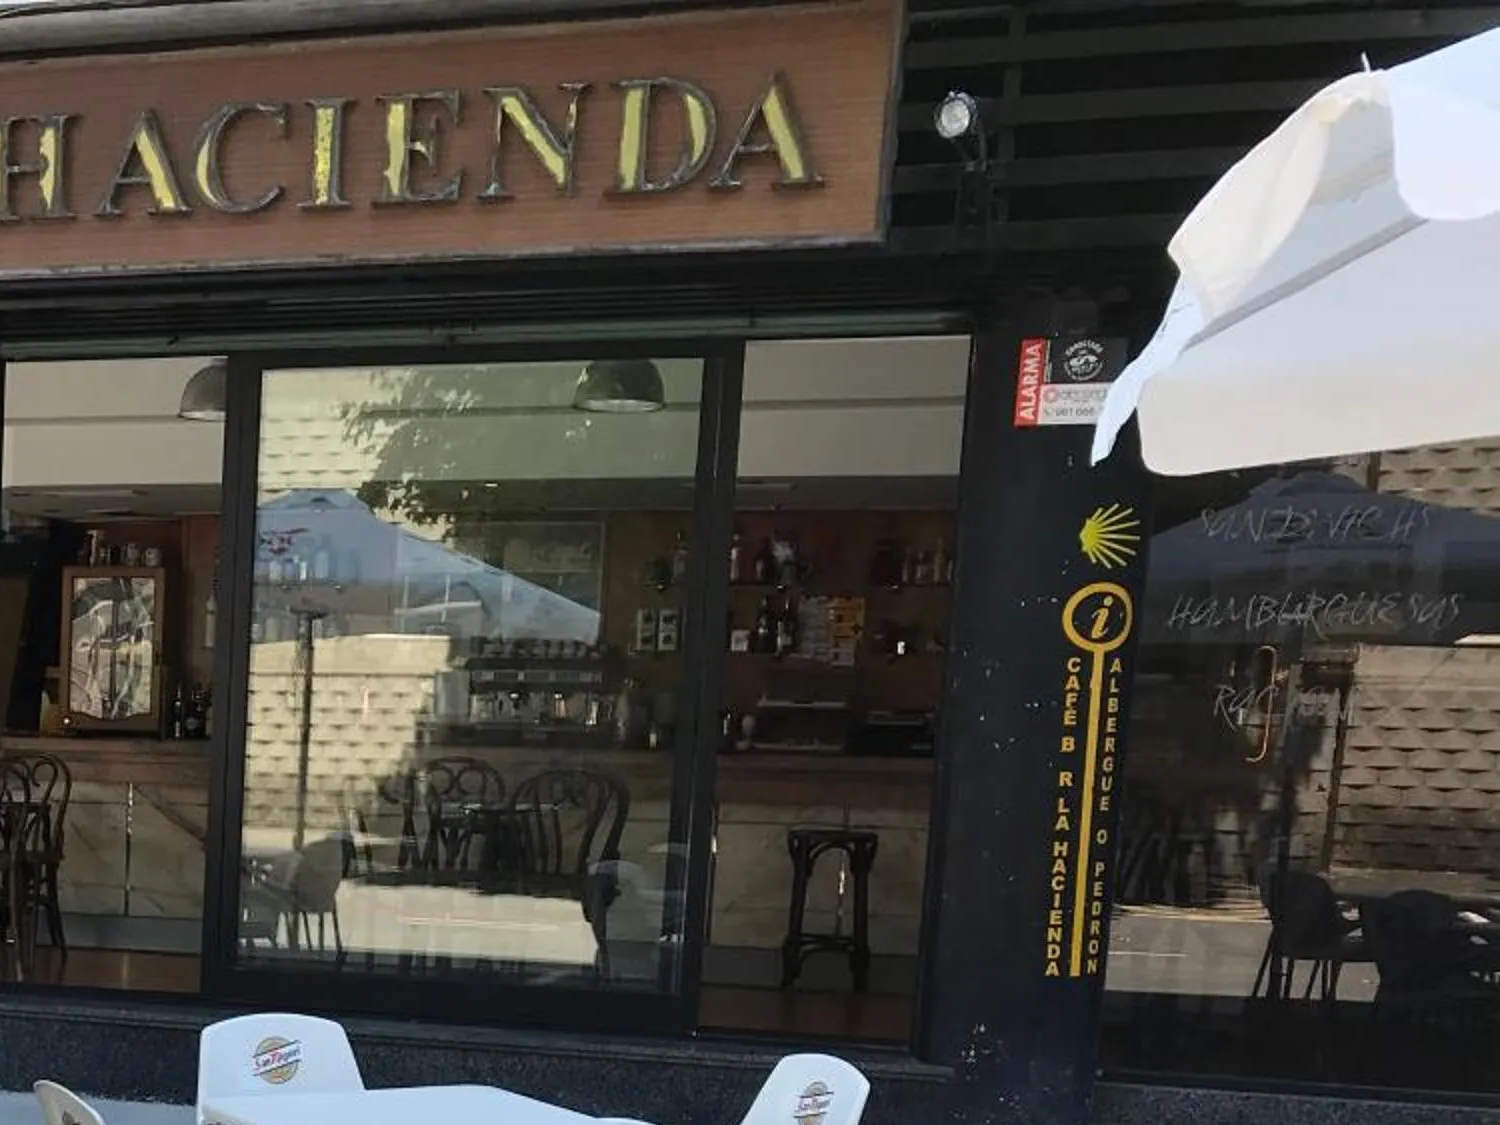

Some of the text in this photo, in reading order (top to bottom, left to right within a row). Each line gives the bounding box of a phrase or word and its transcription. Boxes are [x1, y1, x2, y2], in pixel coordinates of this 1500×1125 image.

[1019, 342, 1042, 420] ALARMA
[1099, 657, 1123, 811] ALBERGUE
[1045, 841, 1069, 977] HACIENDA
